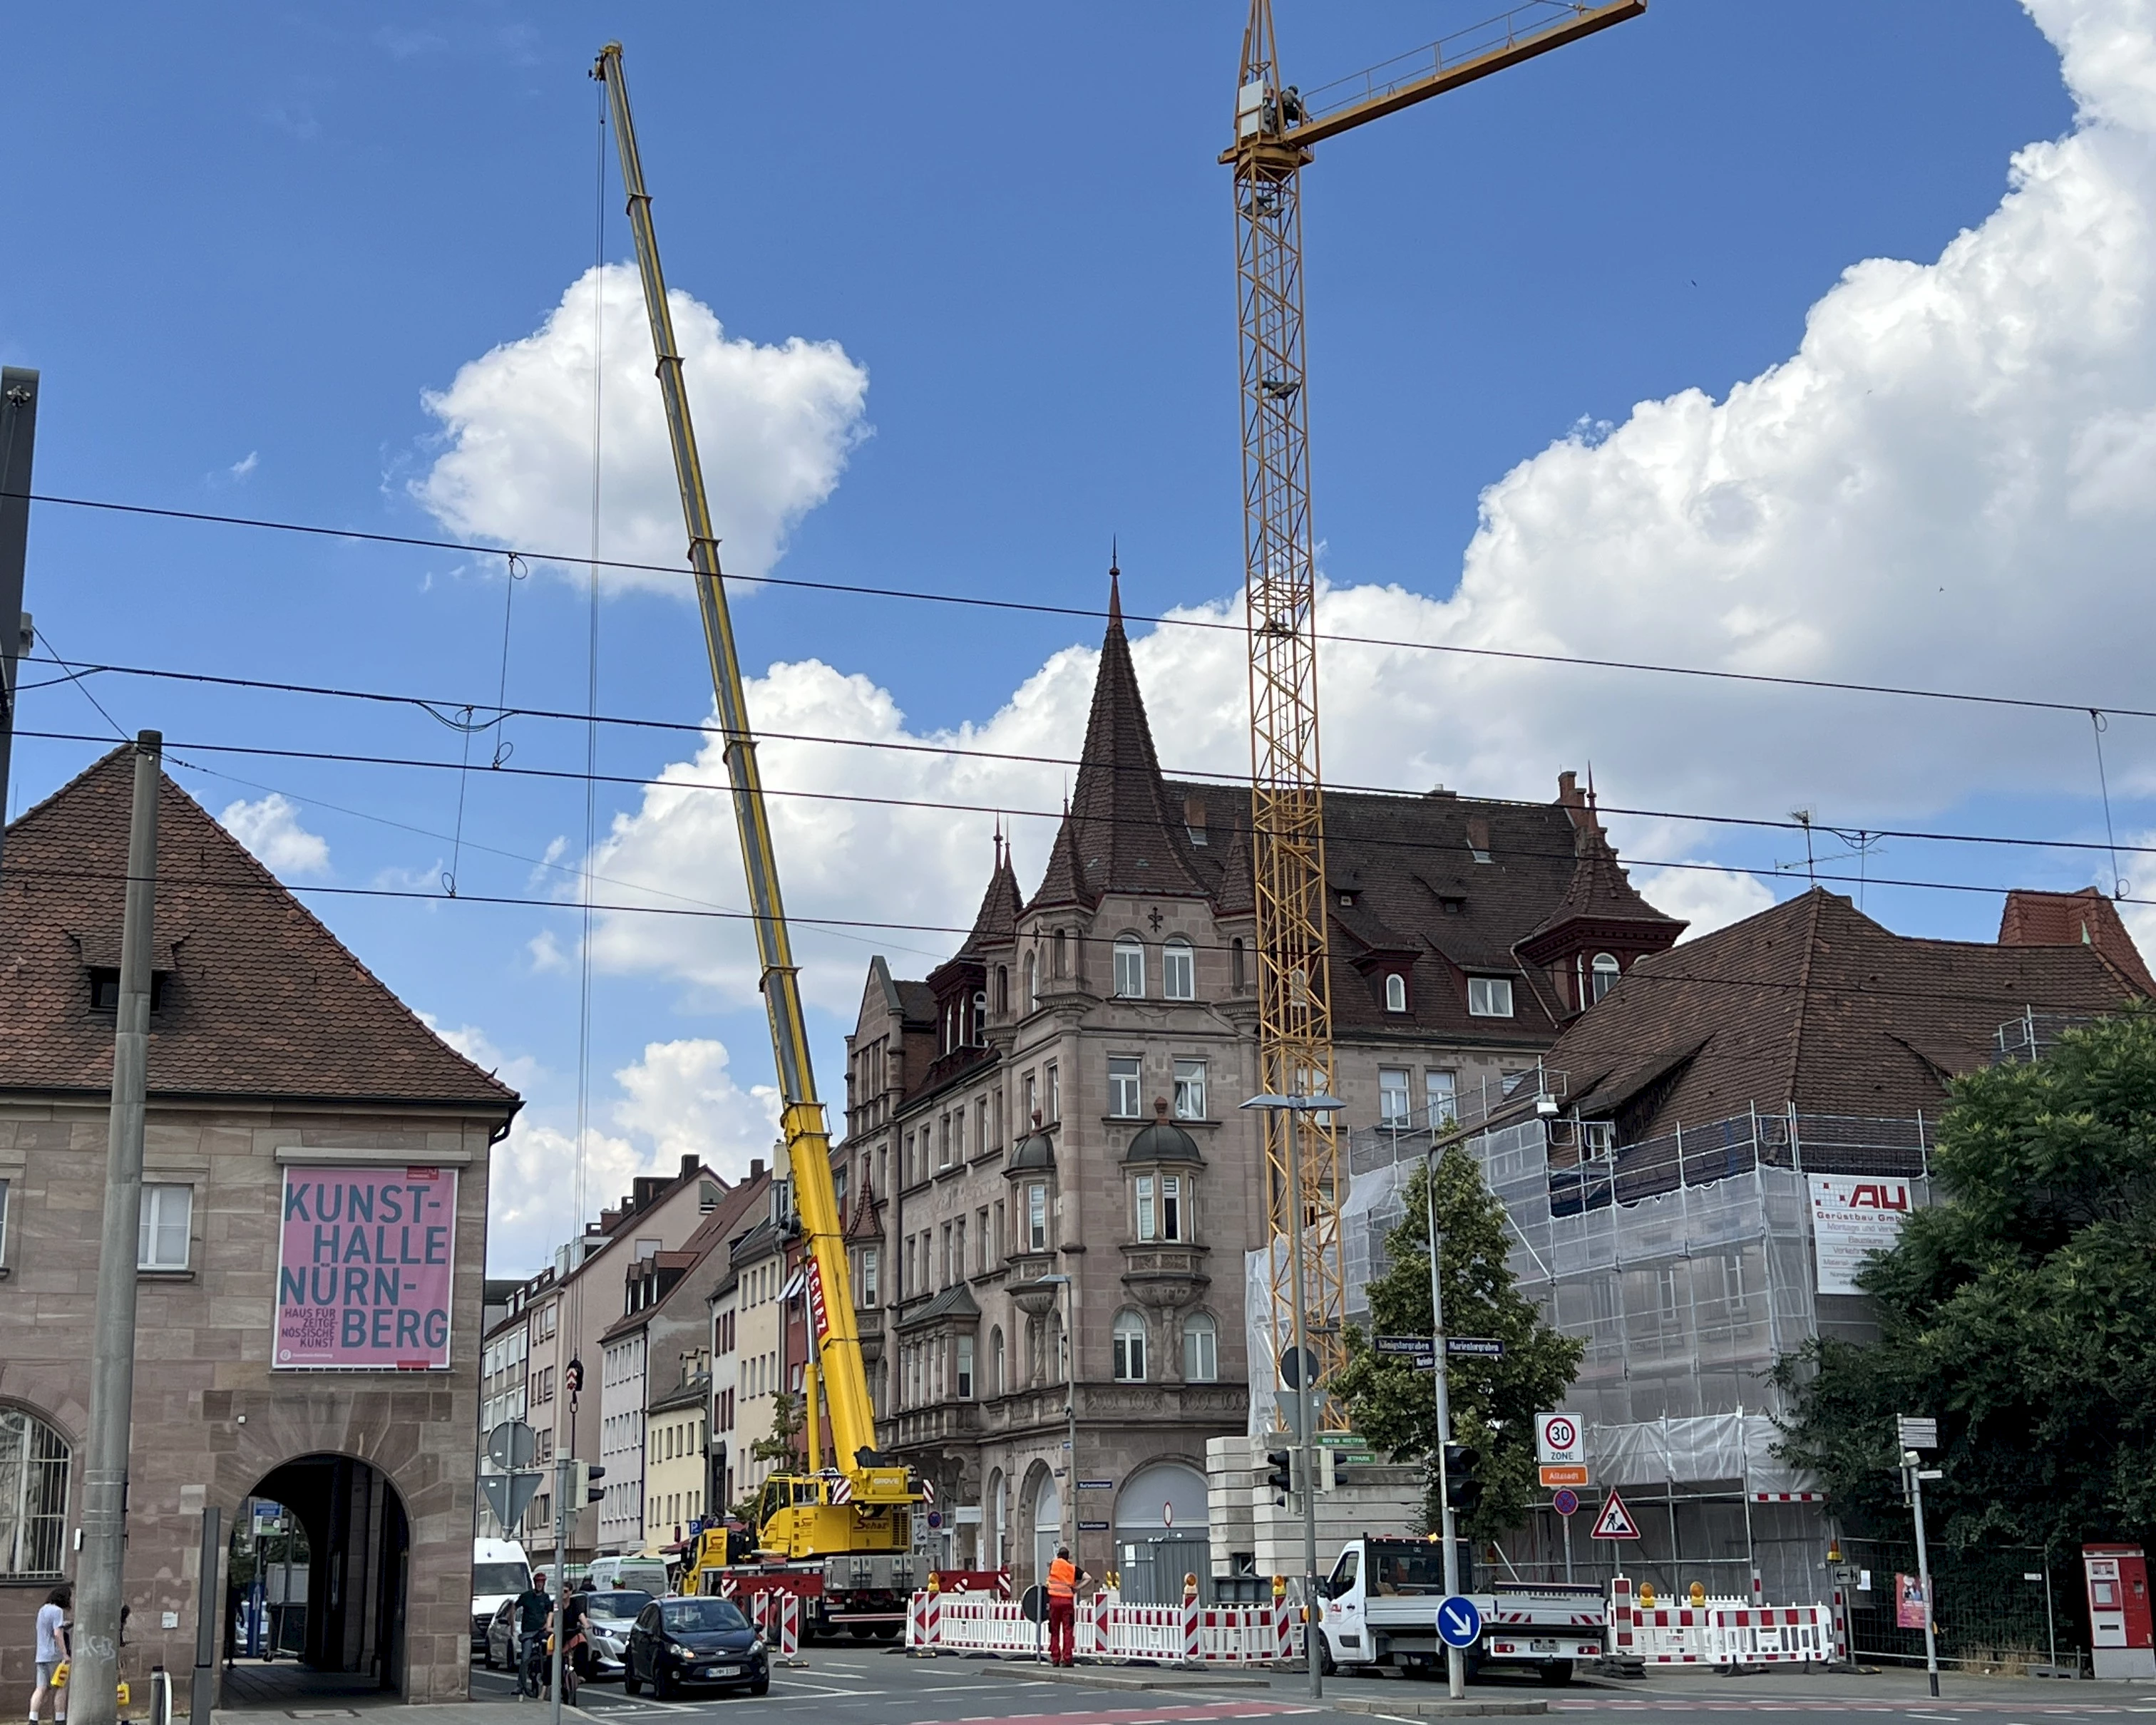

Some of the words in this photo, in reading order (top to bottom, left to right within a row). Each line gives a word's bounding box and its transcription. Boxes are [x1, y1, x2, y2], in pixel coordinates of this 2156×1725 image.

[284, 1183, 440, 1223] KUNST-
[1849, 1185, 1908, 1210] AU
[1817, 1211, 1874, 1221] Gerüstbau
[1827, 1222, 1860, 1234] Montage
[1862, 1224, 1875, 1232] und
[313, 1225, 447, 1265] HALLE
[279, 1262, 416, 1305] NÜRN-
[284, 1308, 313, 1318] HAUS
[316, 1307, 336, 1318] FÜR
[304, 1318, 338, 1328] ZEITGE-
[342, 1309, 448, 1348] BERG
[282, 1327, 334, 1338] NÖSSISCHE
[300, 1338, 334, 1348] KUNST
[1378, 1339, 1429, 1351] Königstorgraben
[1449, 1341, 1499, 1352] Marientorgraben
[1551, 1426, 1570, 1441] 30
[1551, 1452, 1574, 1461] ZONE
[691, 1522, 698, 1533] P
